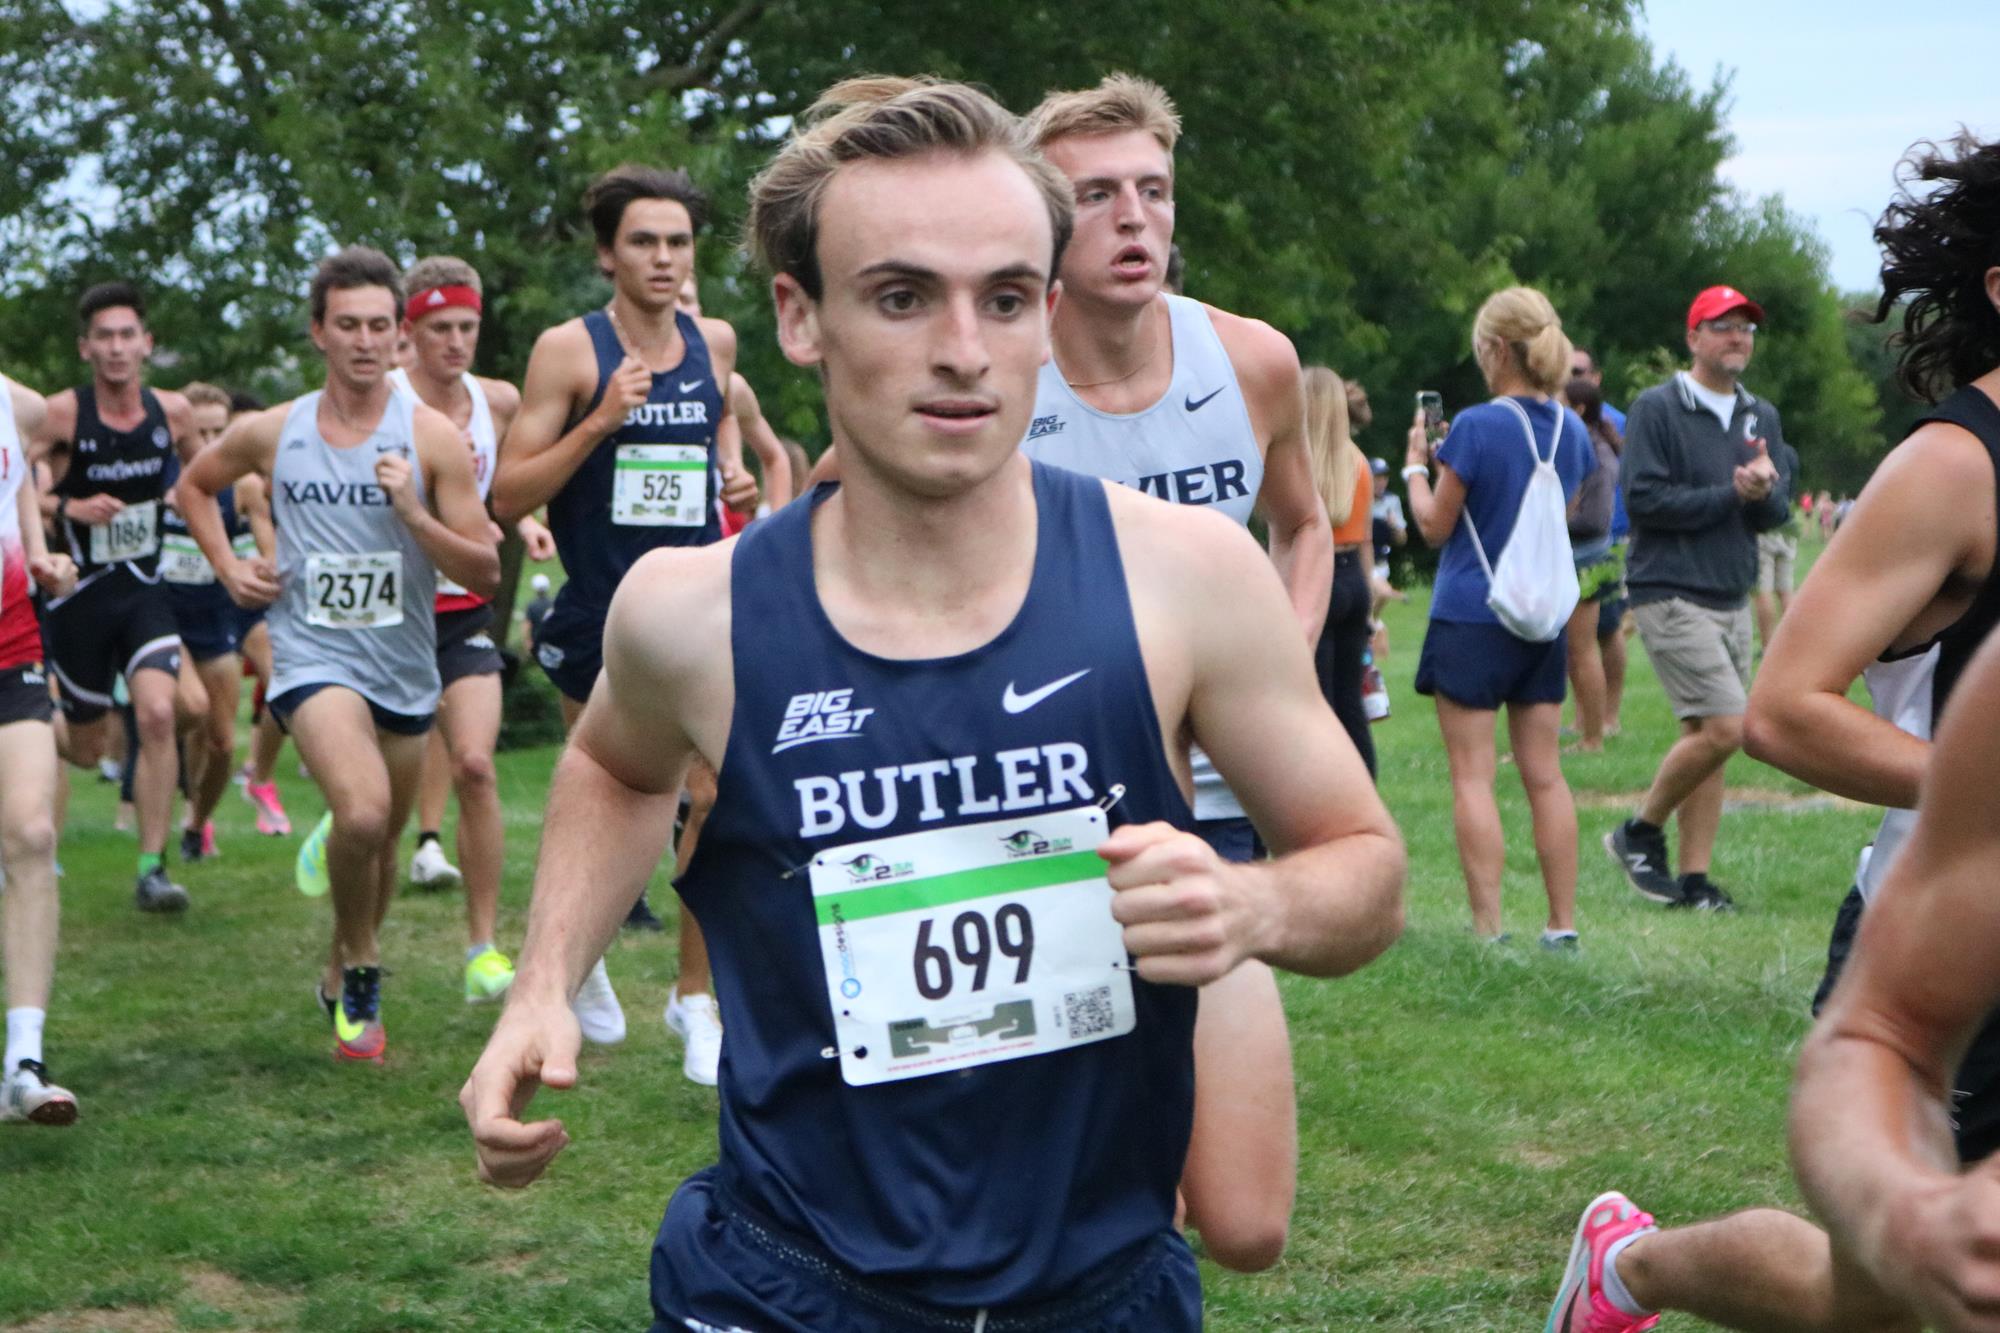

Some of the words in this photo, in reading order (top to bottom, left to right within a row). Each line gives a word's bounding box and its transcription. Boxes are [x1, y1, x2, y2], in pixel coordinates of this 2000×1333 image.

[1029, 422, 1067, 436] EAST
[1032, 415, 1058, 427] BIG
[643, 474, 682, 501] 525
[317, 572, 396, 609] 2374
[784, 688, 854, 720] BIG
[776, 708, 875, 742] EAST
[793, 742, 1095, 838] BUTLER
[913, 902, 1035, 1001] 699
